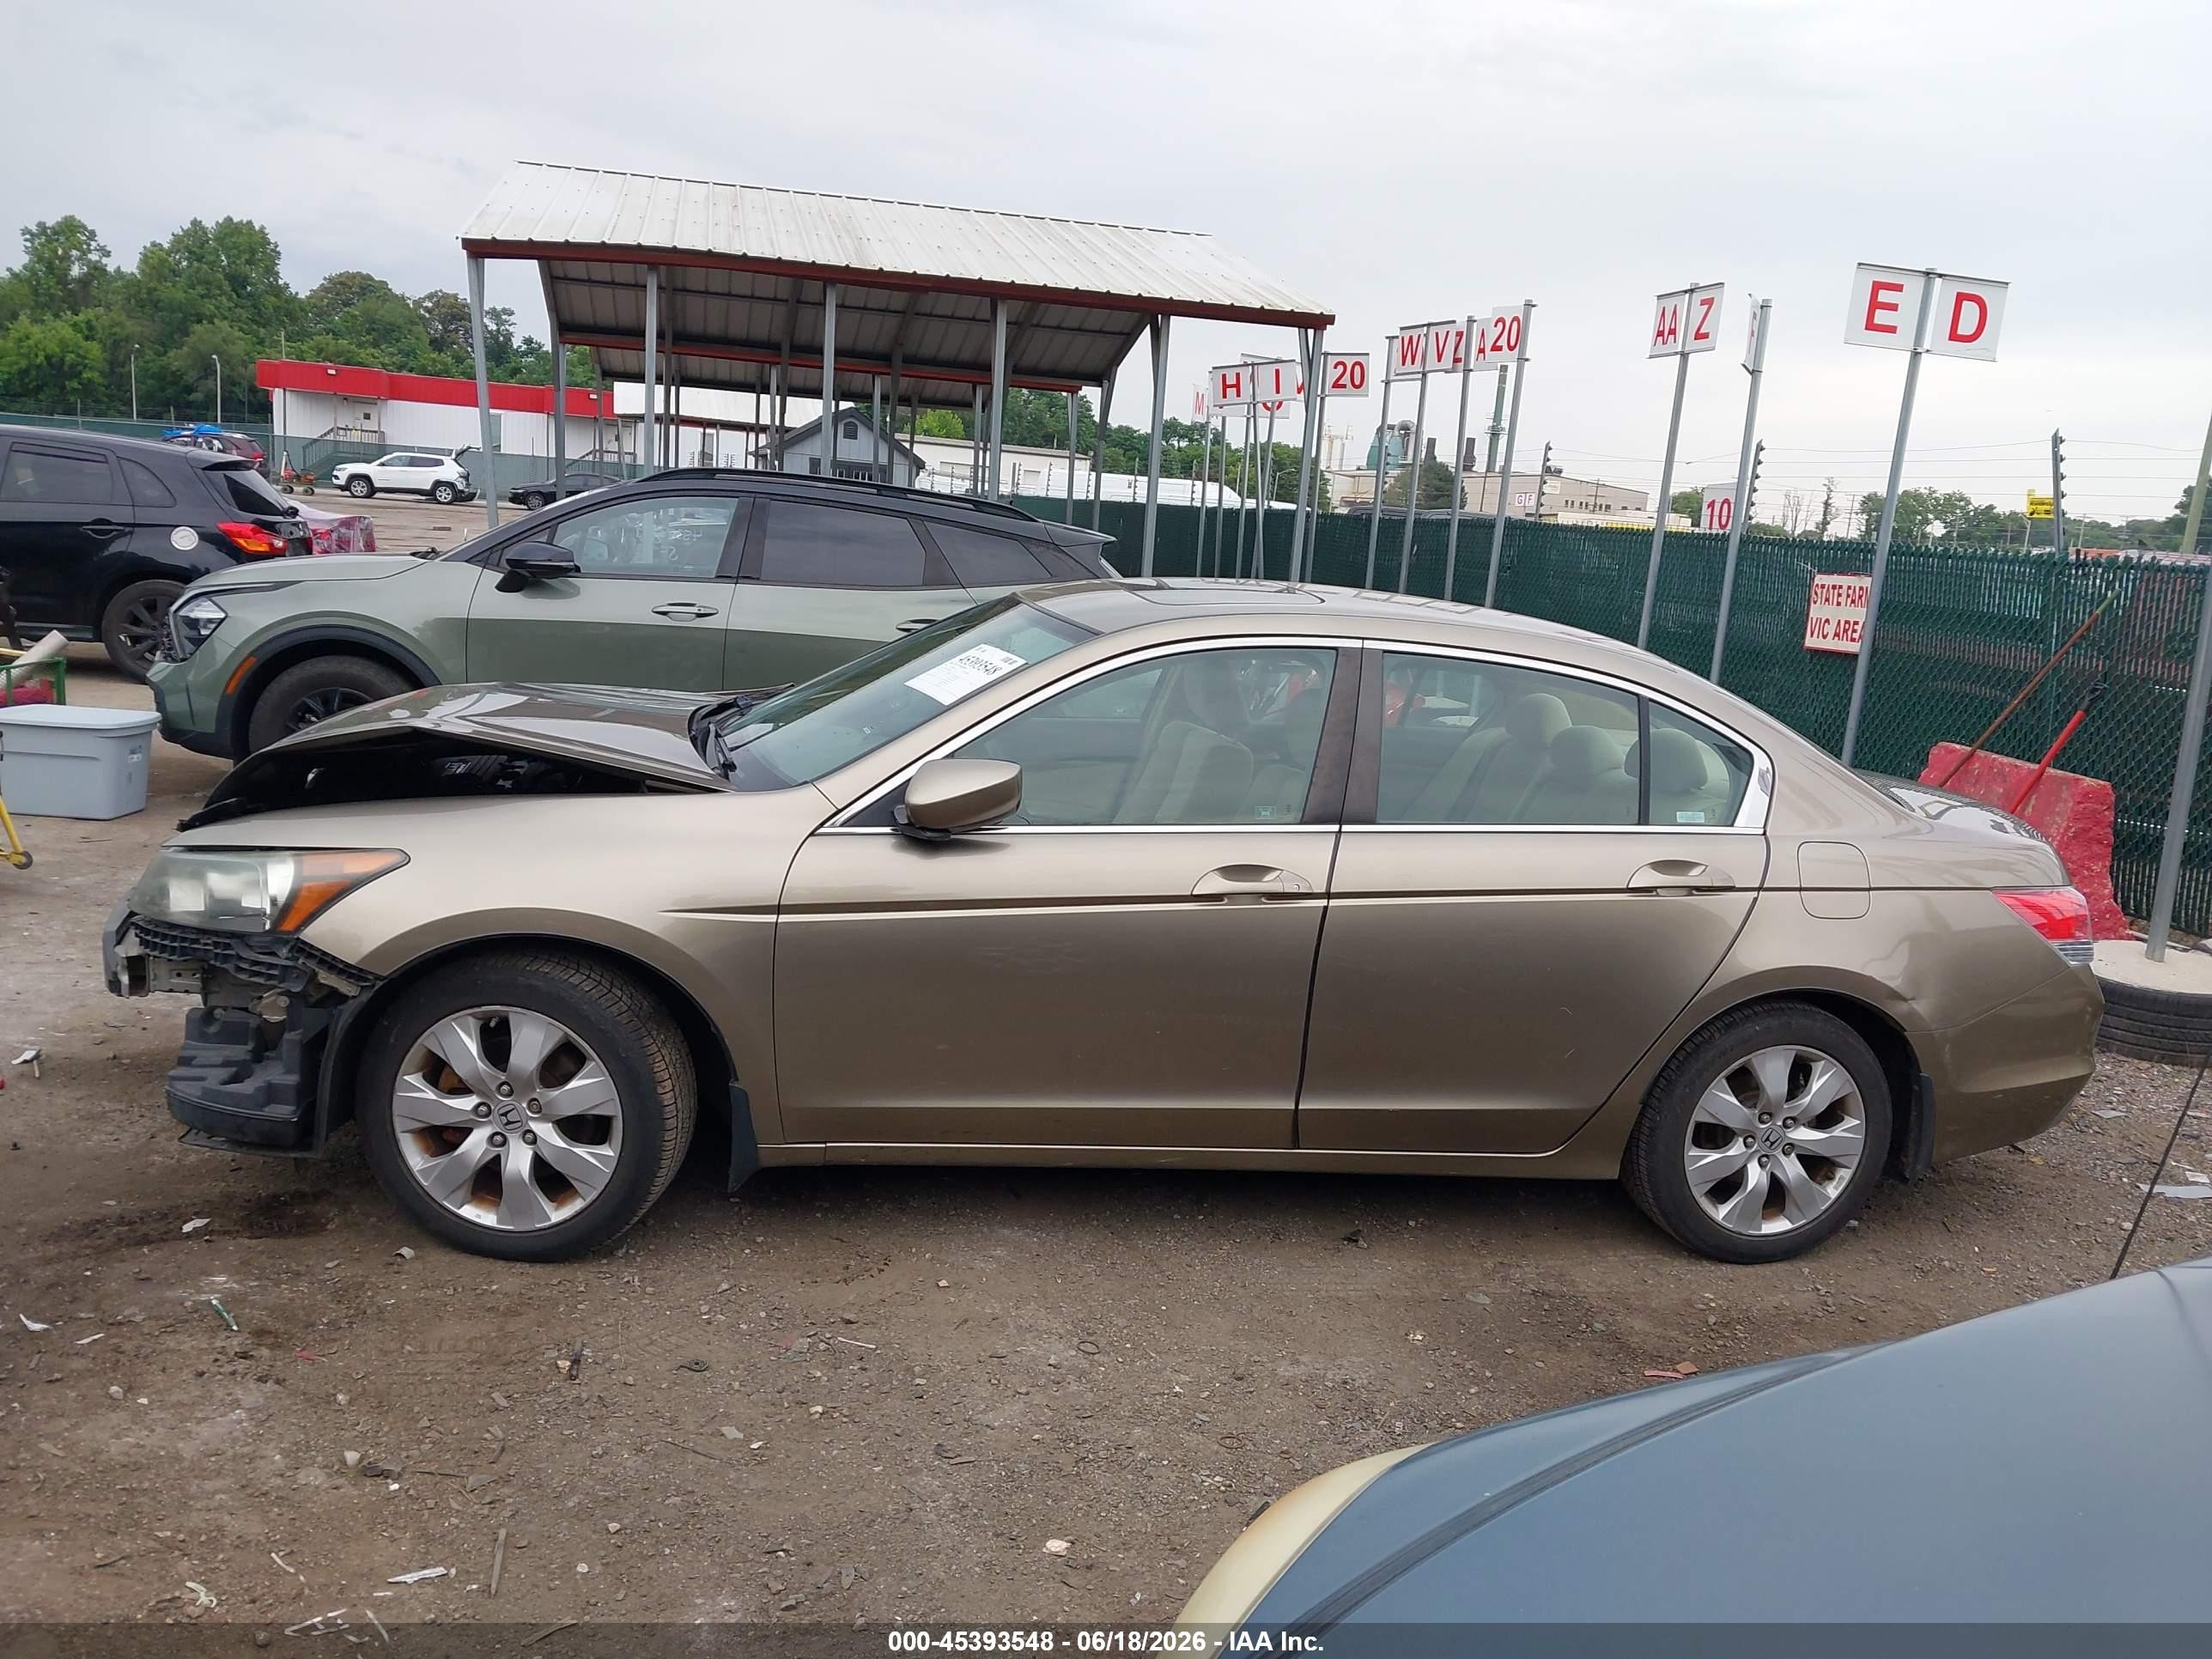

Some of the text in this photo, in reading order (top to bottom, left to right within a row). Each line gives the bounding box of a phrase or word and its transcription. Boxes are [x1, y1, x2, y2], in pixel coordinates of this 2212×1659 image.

[1693, 296, 1715, 341] Z
[1864, 280, 1905, 335] E
[1948, 291, 1988, 343] D
[1489, 315, 1522, 353] 20
[1654, 304, 1678, 347] AA
[1401, 333, 1422, 367] W
[1435, 330, 1450, 363] V
[1221, 371, 1242, 399] H
[1274, 368, 1281, 395] I
[1331, 360, 1365, 390] 20
[1194, 391, 1205, 416] M
[1516, 495, 1523, 505] G
[1706, 498, 1732, 531] 10
[1812, 582, 1844, 607] STATE
[1809, 617, 1831, 640] VIC
